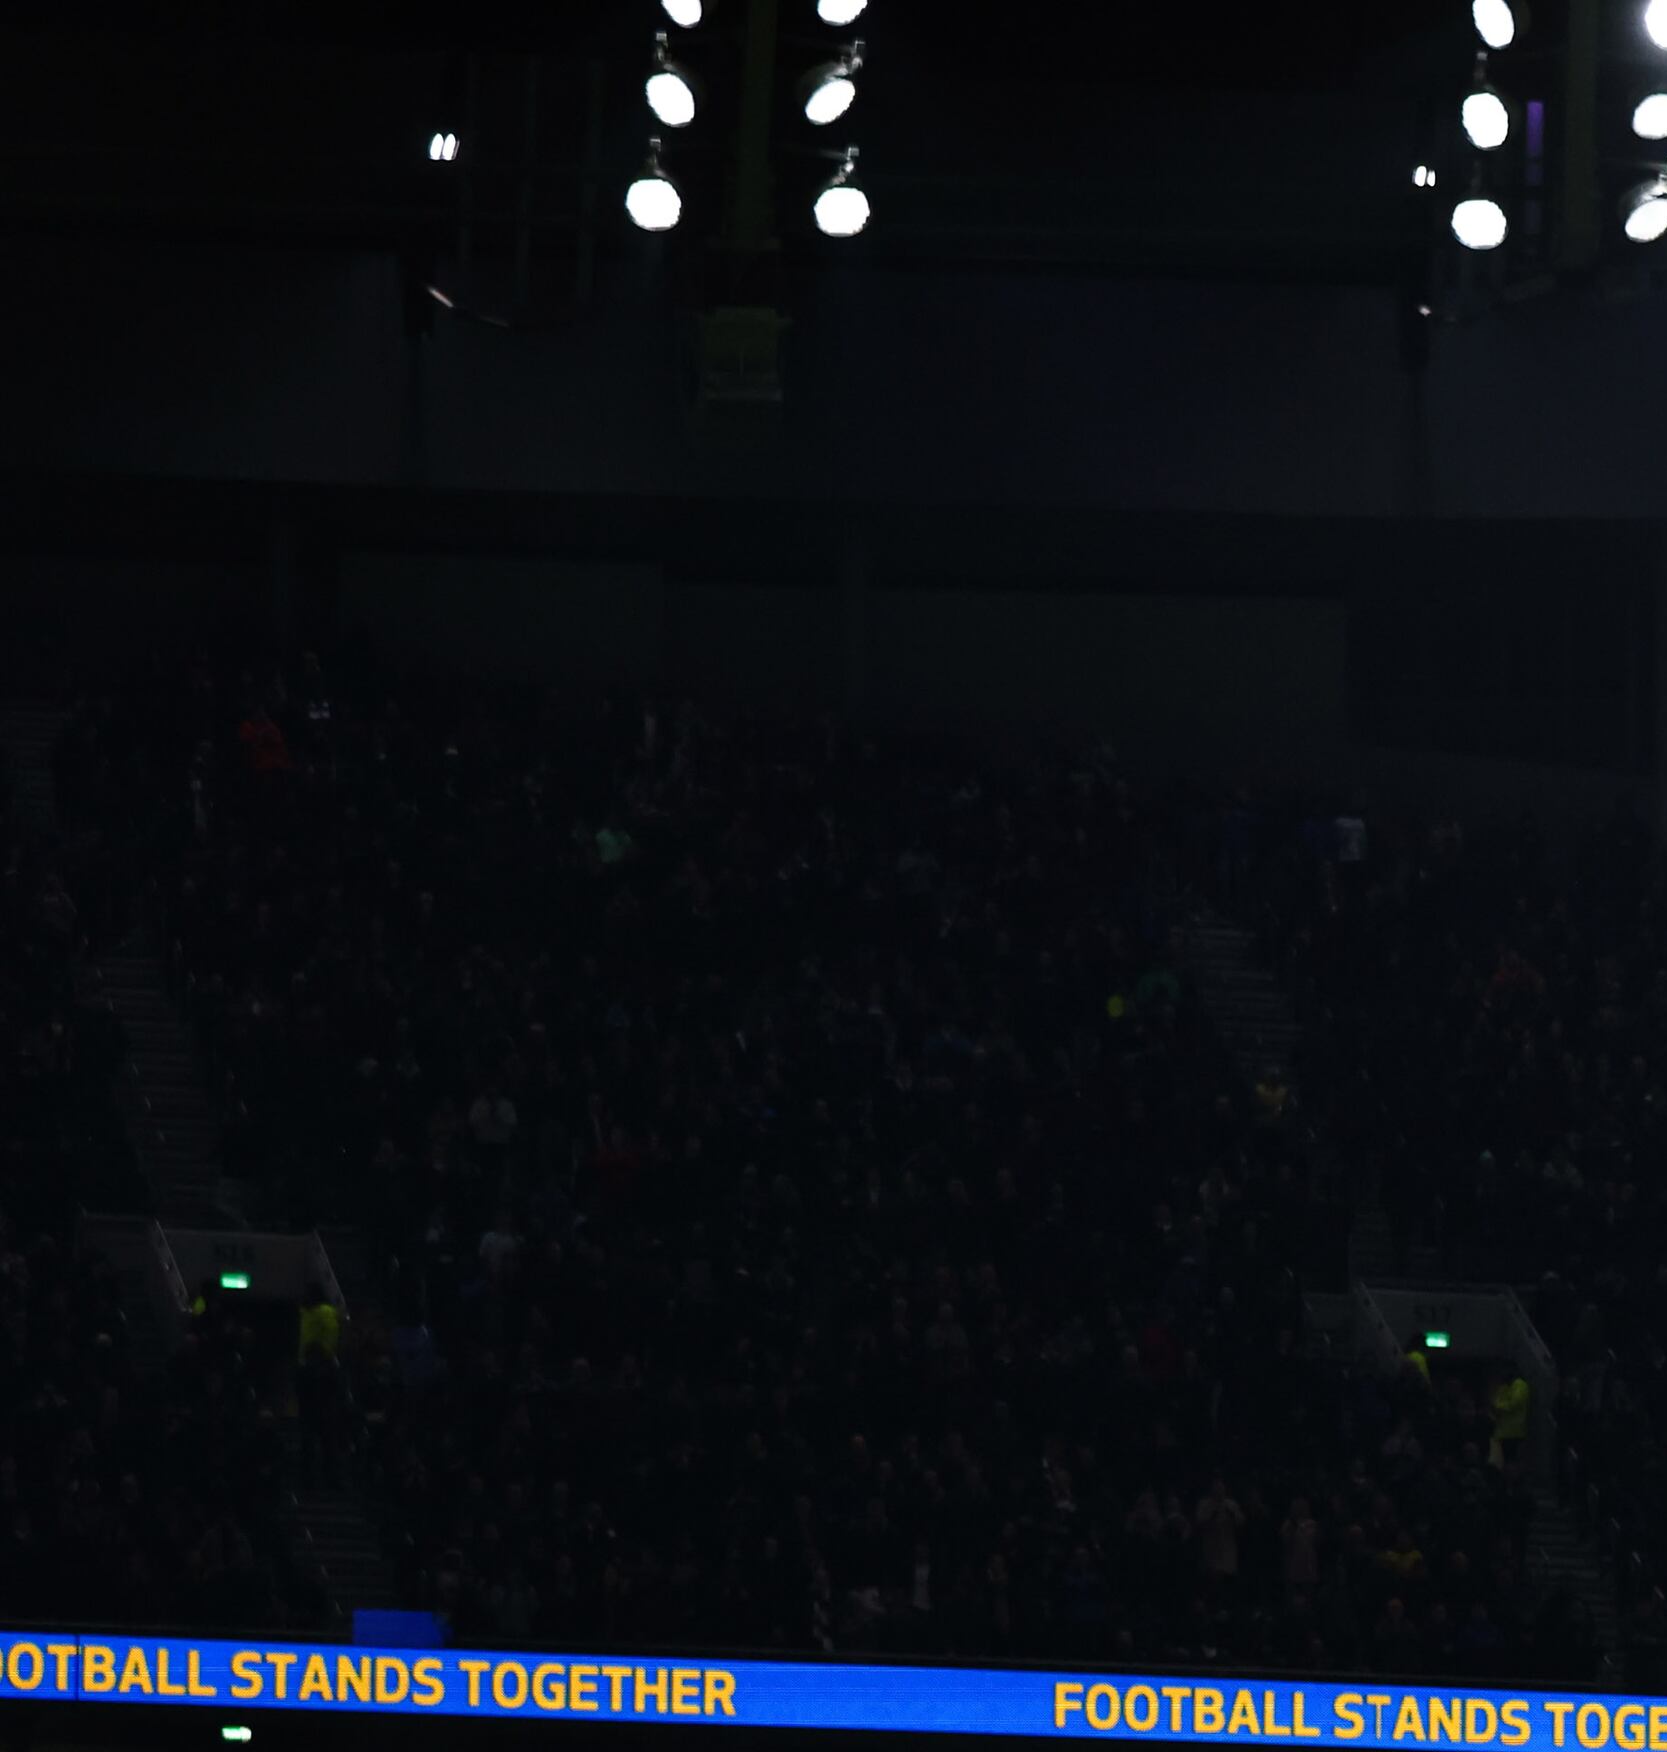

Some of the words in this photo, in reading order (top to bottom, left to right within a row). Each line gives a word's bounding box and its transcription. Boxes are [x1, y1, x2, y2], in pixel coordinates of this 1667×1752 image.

[0, 1644, 215, 1695] OTBALL
[232, 1652, 443, 1704] STANDS
[460, 1661, 735, 1714] TOGETHER
[1056, 1684, 1319, 1736] FOOTBALL
[1335, 1694, 1529, 1744] STANDS
